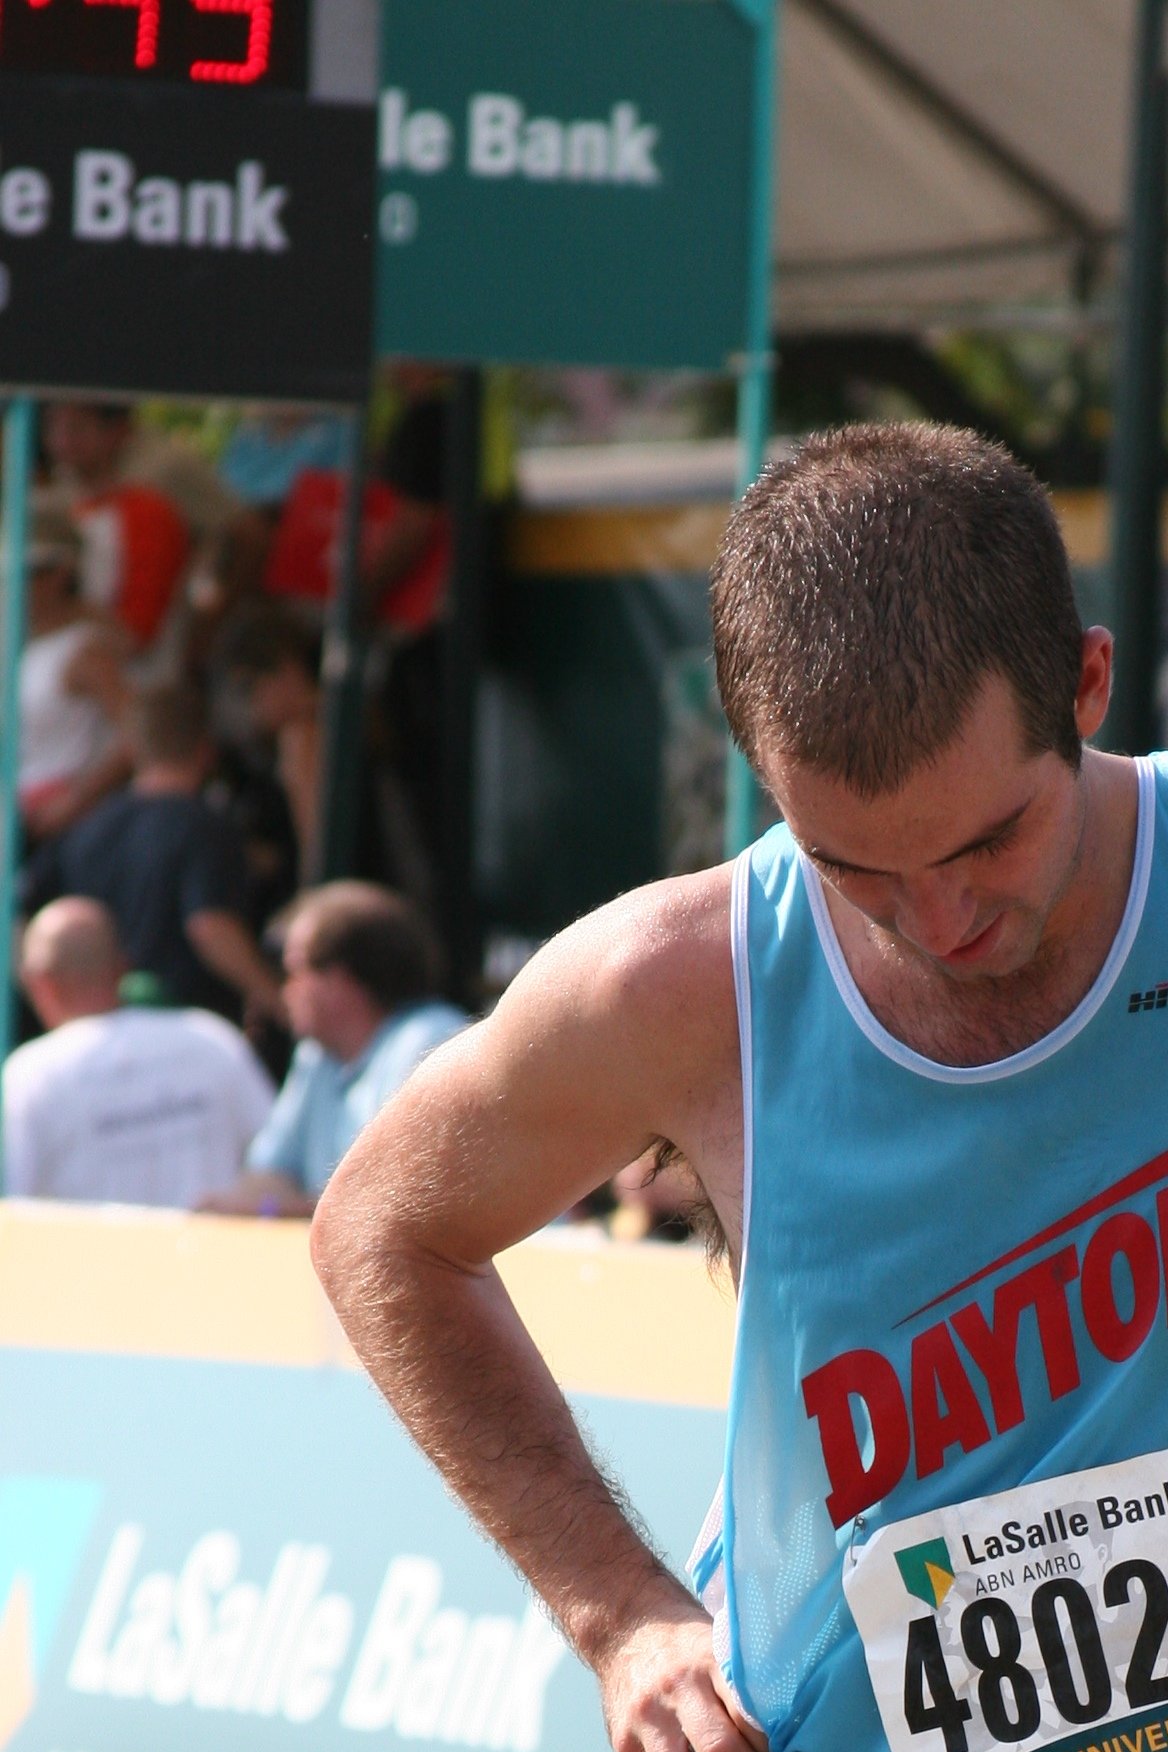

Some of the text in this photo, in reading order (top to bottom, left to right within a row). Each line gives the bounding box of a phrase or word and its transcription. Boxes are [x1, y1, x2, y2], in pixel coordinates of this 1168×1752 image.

[467, 92, 660, 185] Bank
[73, 148, 290, 254] Bank
[962, 1509, 1089, 1565] LaSalle
[975, 1552, 1081, 1596] ABN AMRO
[65, 1520, 354, 1724] LaSalle
